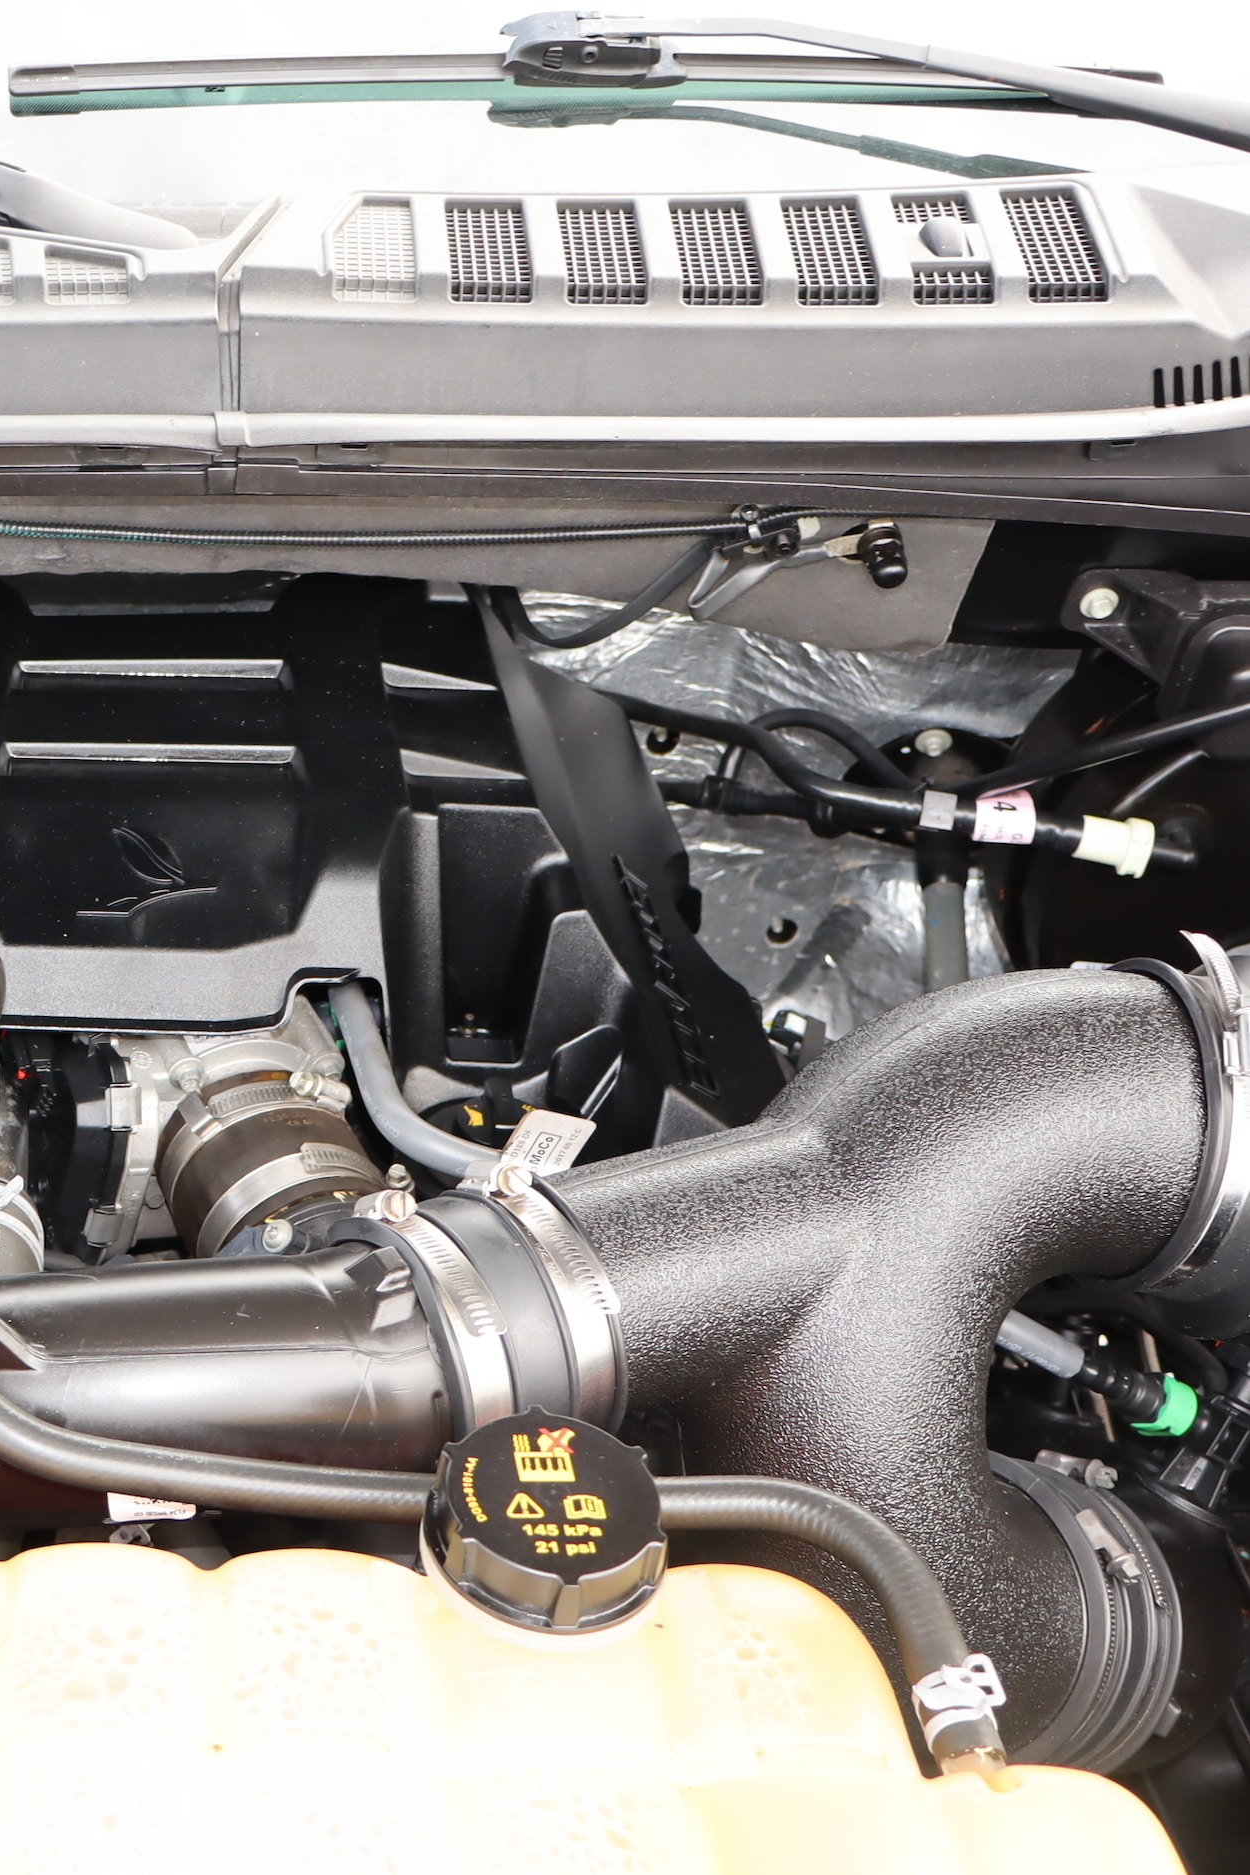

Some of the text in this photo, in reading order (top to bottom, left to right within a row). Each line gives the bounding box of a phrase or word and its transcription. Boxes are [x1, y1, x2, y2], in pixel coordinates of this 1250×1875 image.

[521, 1523, 603, 1537] 145 kPa
[534, 1541, 597, 1557] 21 psi
